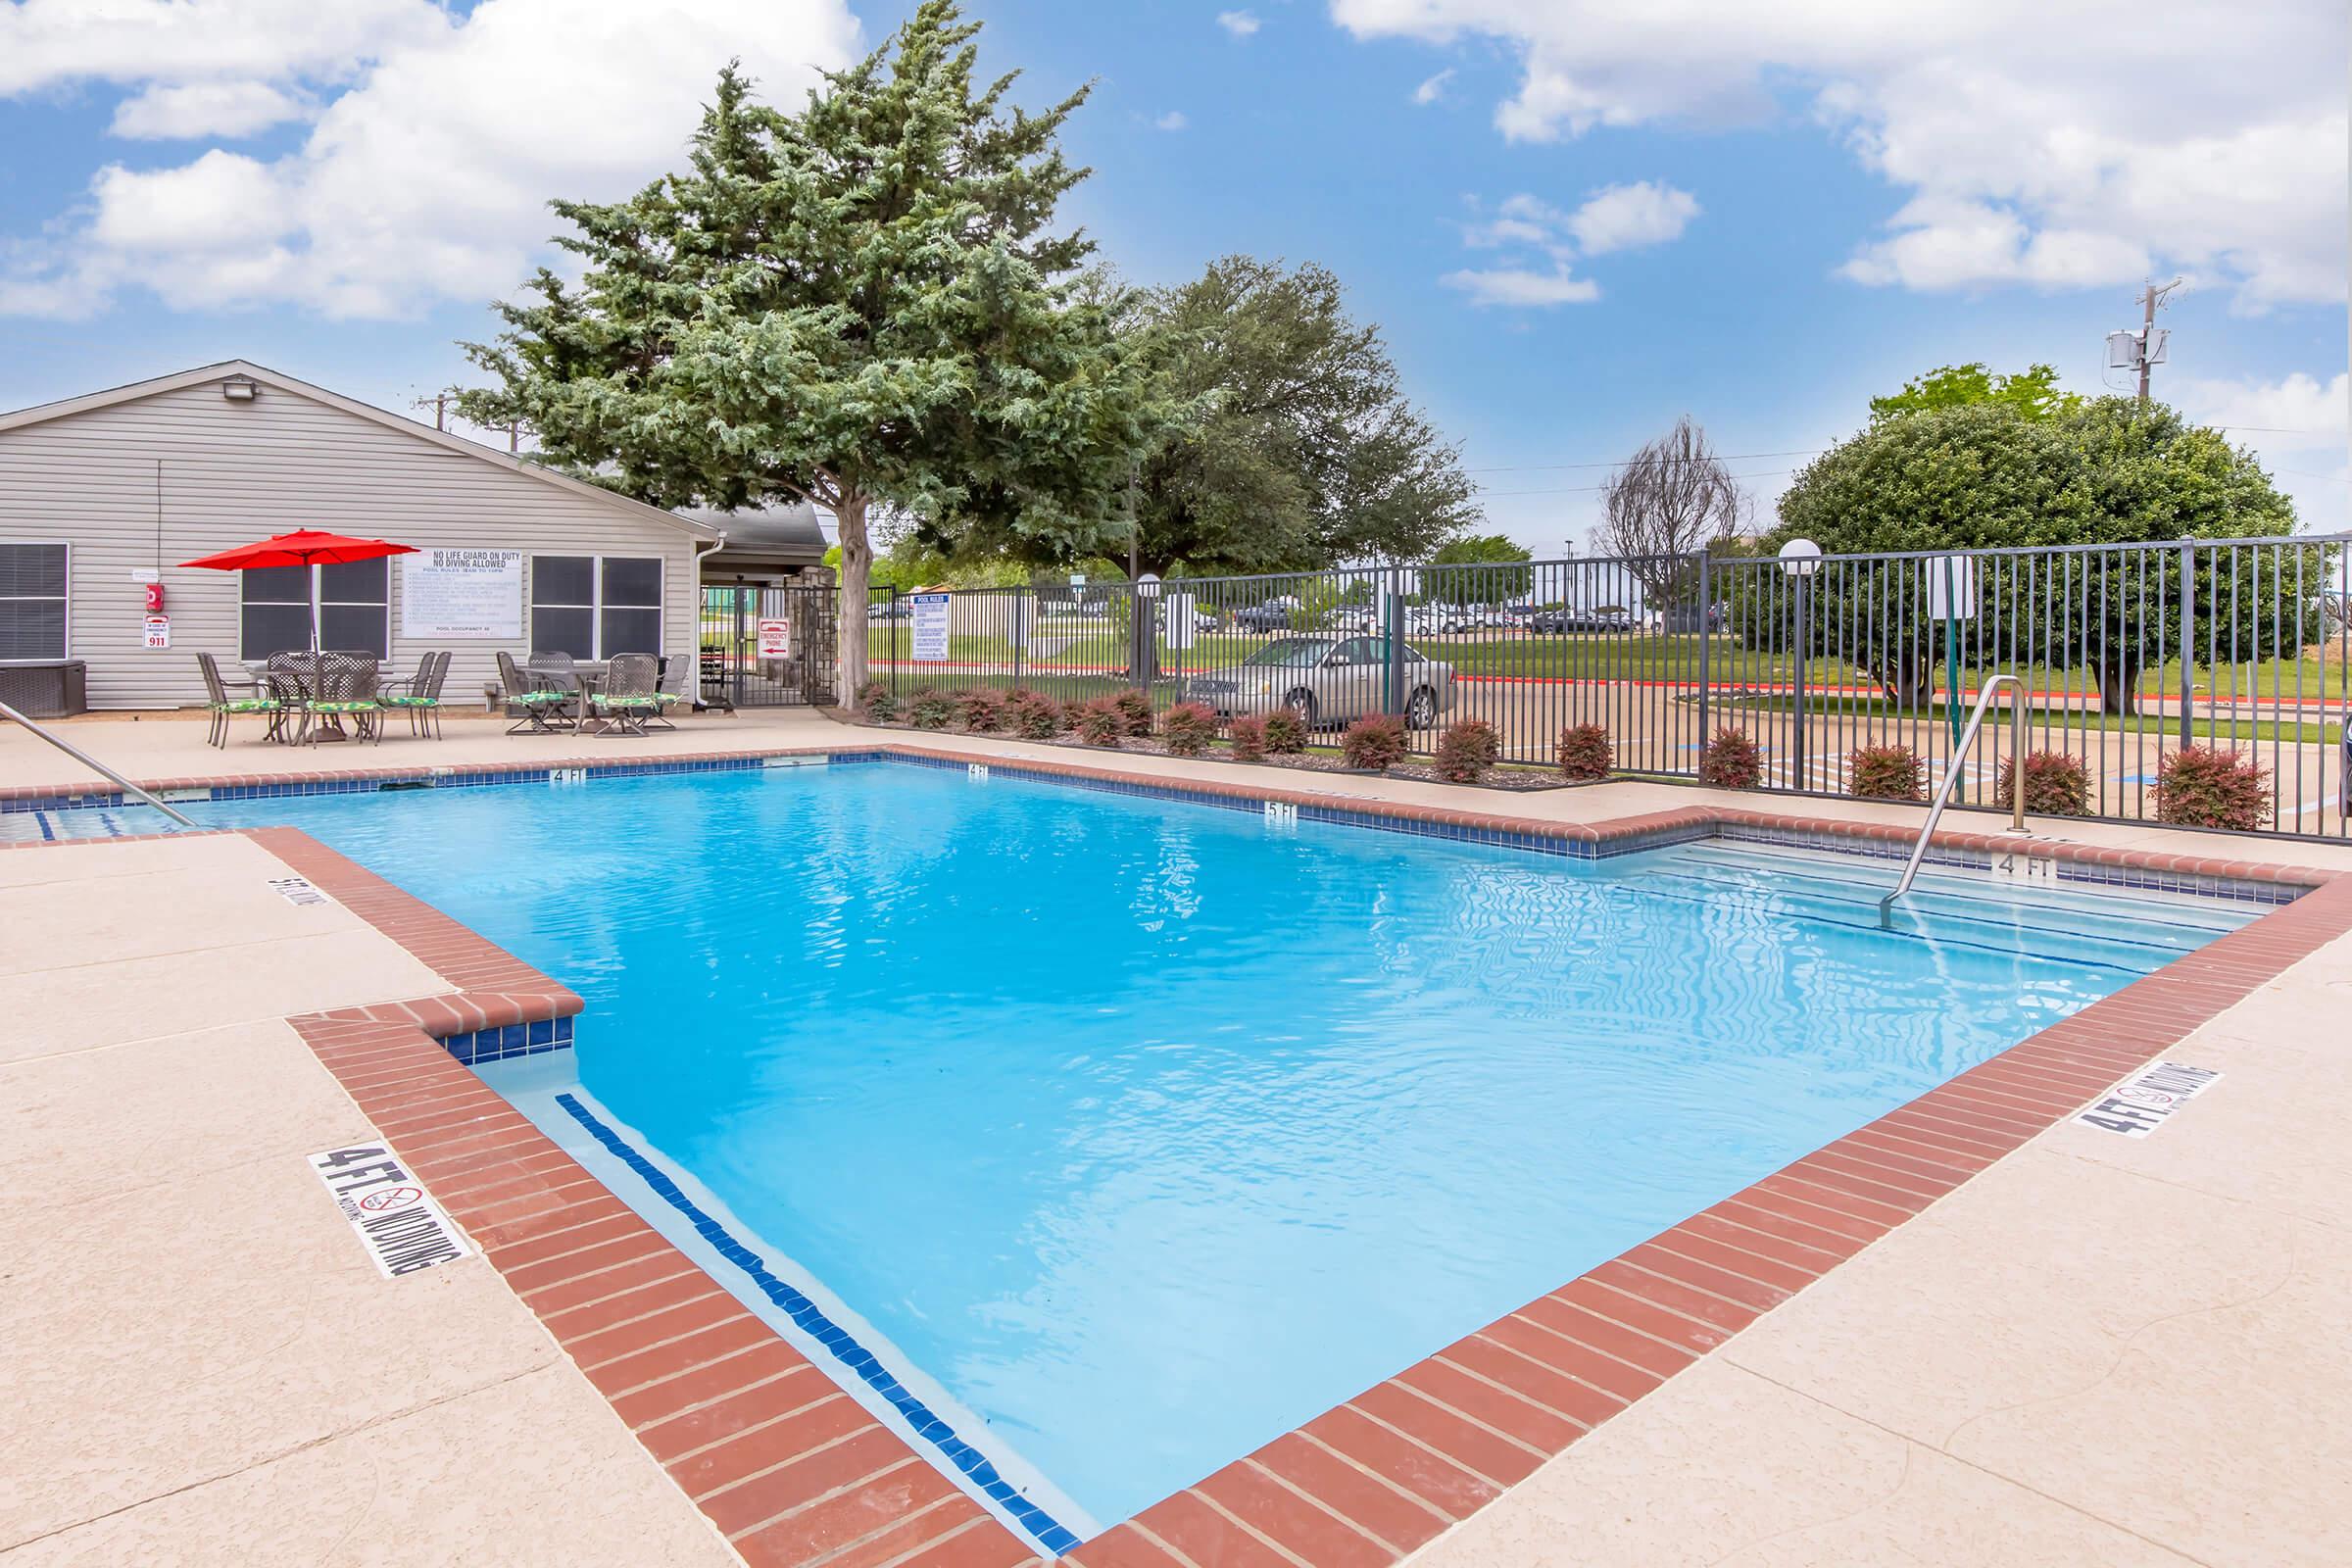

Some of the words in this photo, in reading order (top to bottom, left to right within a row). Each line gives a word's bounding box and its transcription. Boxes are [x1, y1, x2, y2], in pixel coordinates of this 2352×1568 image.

[445, 560, 470, 568] DIVING
[472, 560, 506, 568] ALLOWED
[446, 551, 461, 560] LIFE
[463, 552, 488, 560] GUARD
[490, 552, 499, 560] ON
[502, 552, 520, 561] DUTY
[149, 637, 165, 646] 911
[554, 769, 563, 780] 4
[1269, 803, 1277, 816] 5
[1282, 804, 1294, 817] FT
[1999, 854, 2014, 873] 4
[2028, 857, 2051, 877] FT
[2081, 1114, 2151, 1133] 4
[318, 1148, 387, 1168] 4
[361, 1206, 432, 1233] NO
[370, 1221, 463, 1276] DIVING
